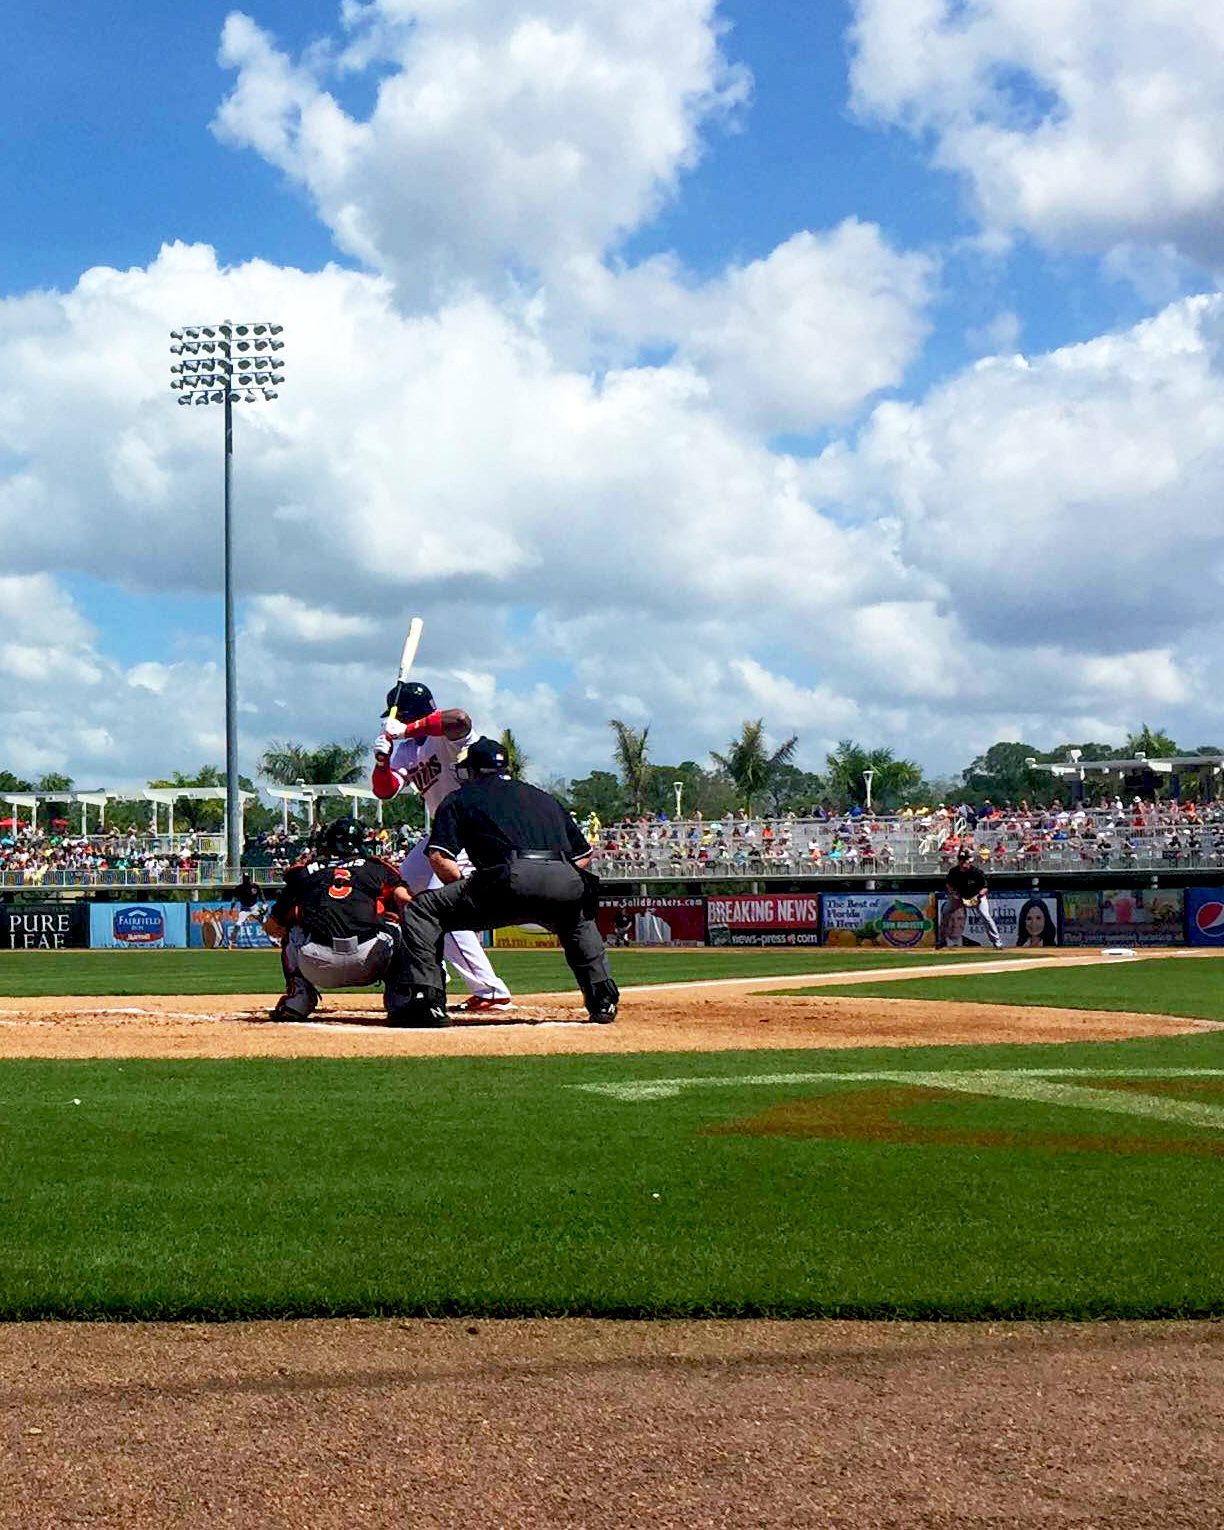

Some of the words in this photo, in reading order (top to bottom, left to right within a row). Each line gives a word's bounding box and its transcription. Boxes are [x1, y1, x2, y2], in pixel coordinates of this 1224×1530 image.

[599, 899, 703, 908] www.SolidBrokers.com
[707, 900, 774, 923] BREAKING
[777, 900, 817, 921] NEWS
[827, 909, 861, 918] Florida
[9, 914, 70, 933] PURE
[9, 933, 66, 949] LEAF
[732, 934, 787, 946] news-press
[429, 1006, 445, 1018] N
